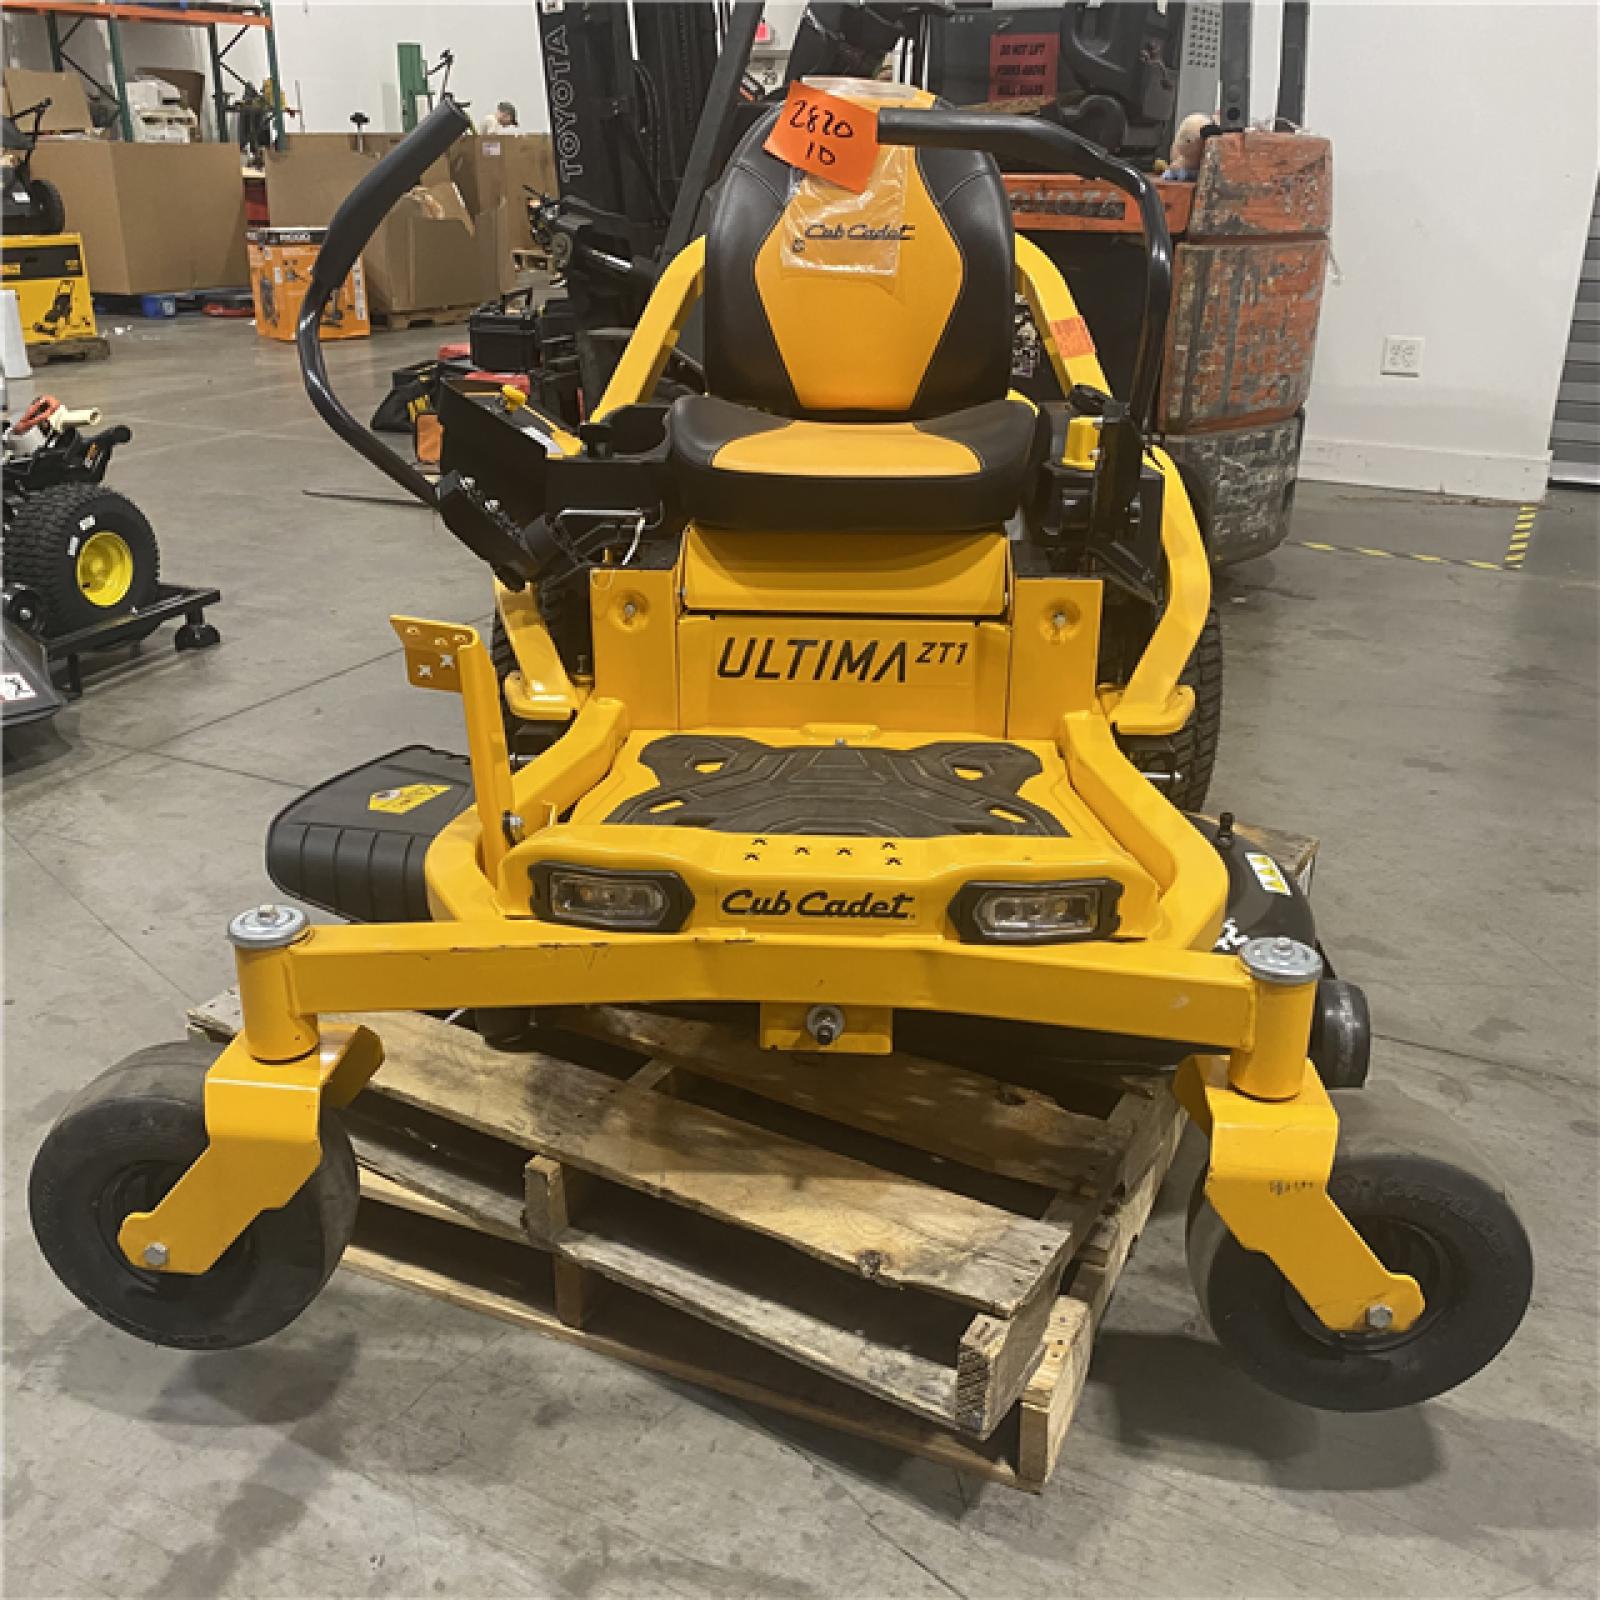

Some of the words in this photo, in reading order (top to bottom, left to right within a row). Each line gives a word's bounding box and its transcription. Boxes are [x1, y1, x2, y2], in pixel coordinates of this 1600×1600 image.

[545, 25, 583, 182] TOYOTA
[789, 100, 853, 137] 2820
[805, 224, 844, 240] Cub
[848, 223, 915, 240] Cadet
[717, 637, 906, 683] ULTIMA
[914, 642, 968, 665] ZT1
[722, 889, 791, 916] Cub
[797, 891, 915, 919] Cadet
